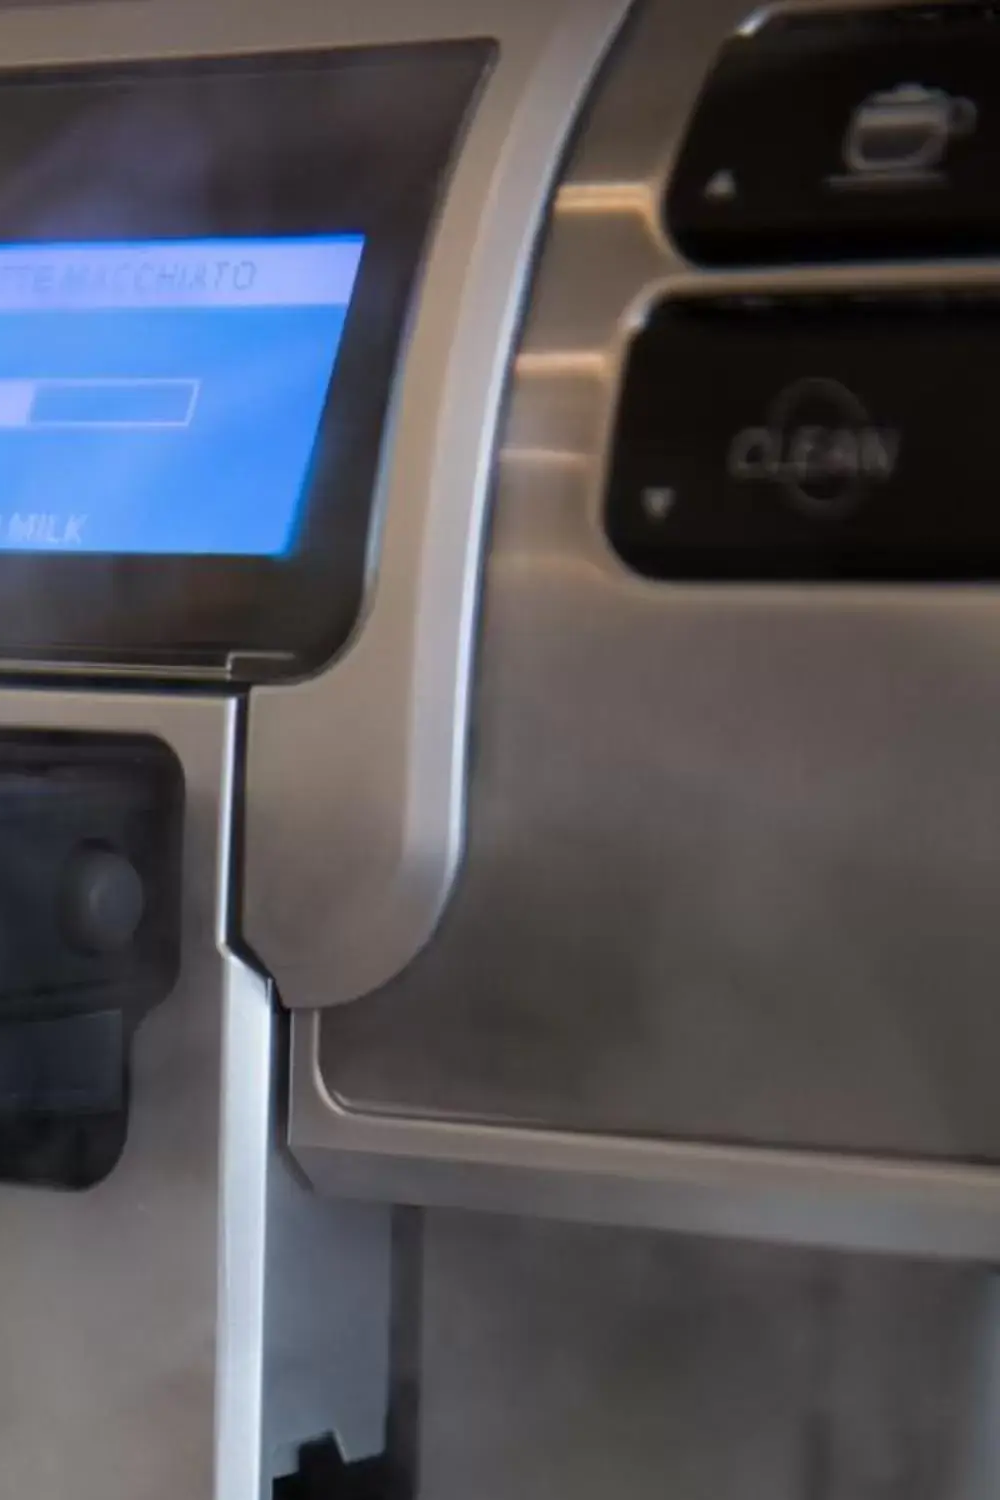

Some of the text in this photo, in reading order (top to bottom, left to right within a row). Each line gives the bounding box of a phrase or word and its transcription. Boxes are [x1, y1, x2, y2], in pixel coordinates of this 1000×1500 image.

[59, 258, 258, 295] MACCHIATO
[728, 426, 900, 479] CLEAN
[7, 511, 90, 545] MILK
